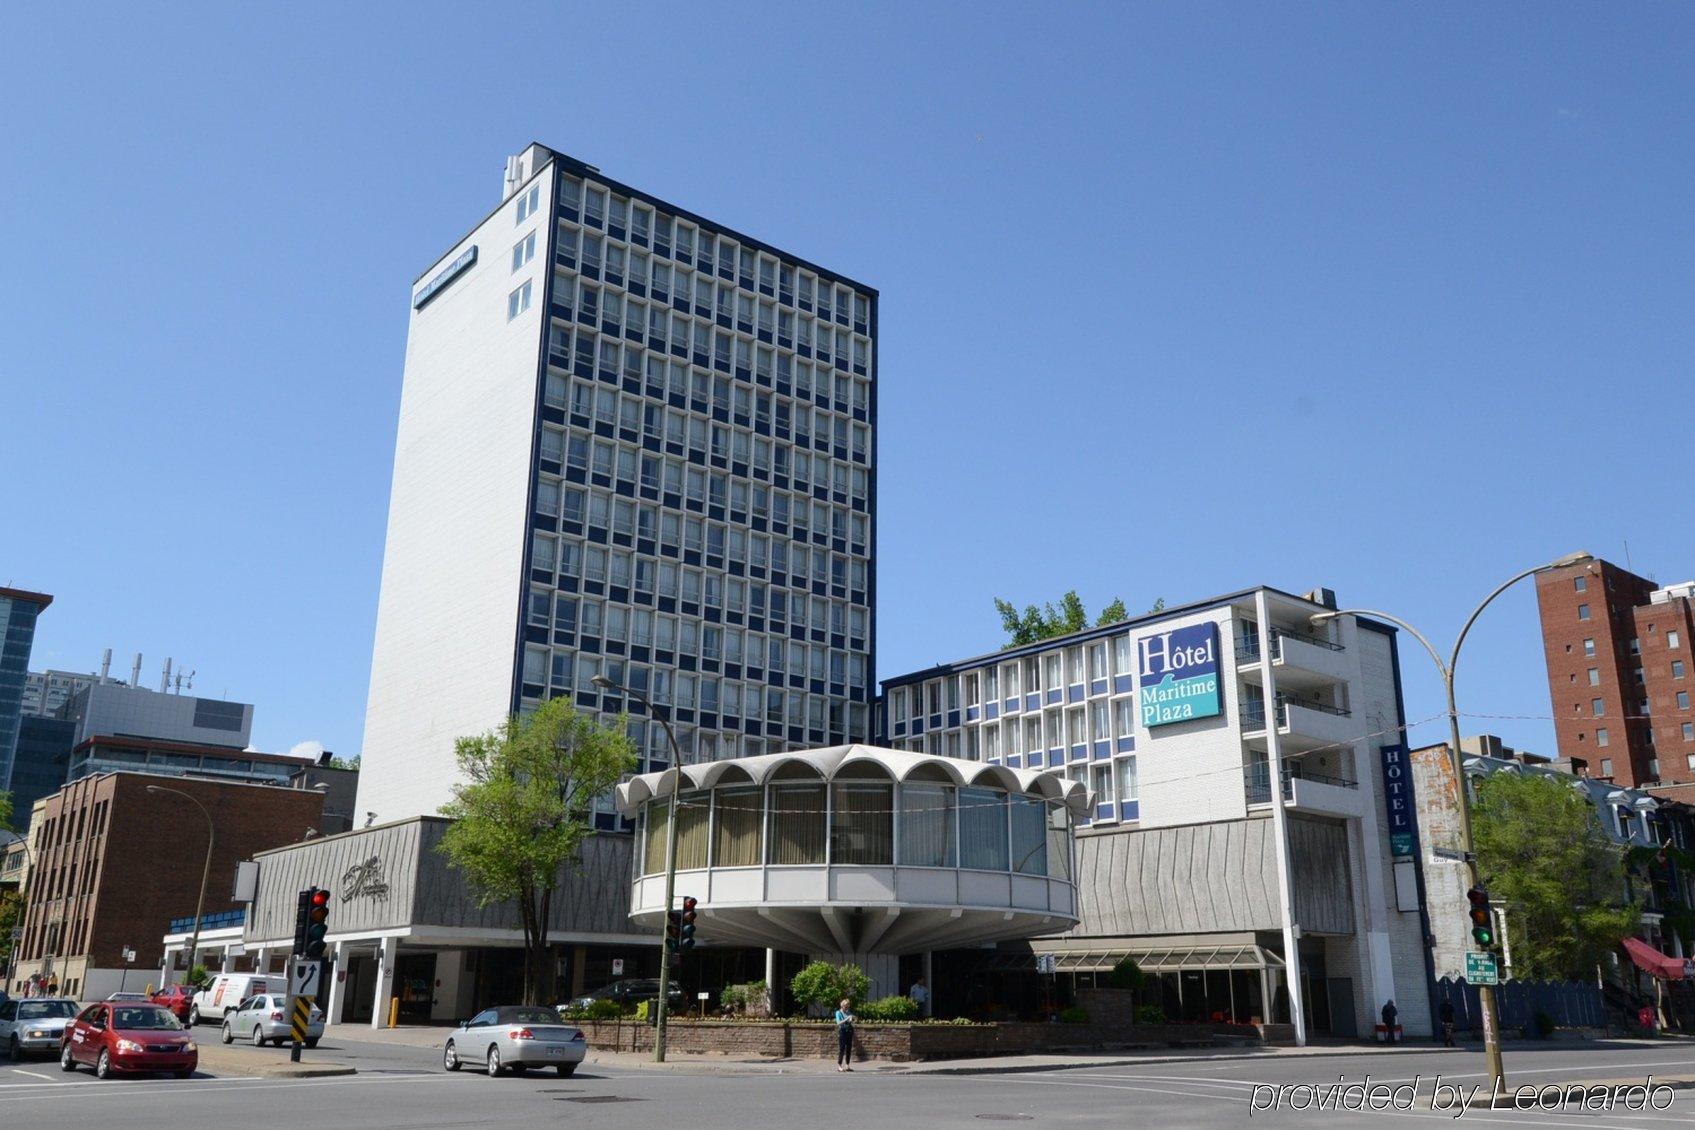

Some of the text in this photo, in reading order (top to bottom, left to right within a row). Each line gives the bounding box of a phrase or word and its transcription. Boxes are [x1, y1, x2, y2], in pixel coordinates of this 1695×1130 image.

[1138, 632, 1215, 677] Hôtel
[1142, 679, 1217, 705] Maritime
[1143, 703, 1193, 725] Plaza
[1386, 751, 1406, 826] HÔTEL
